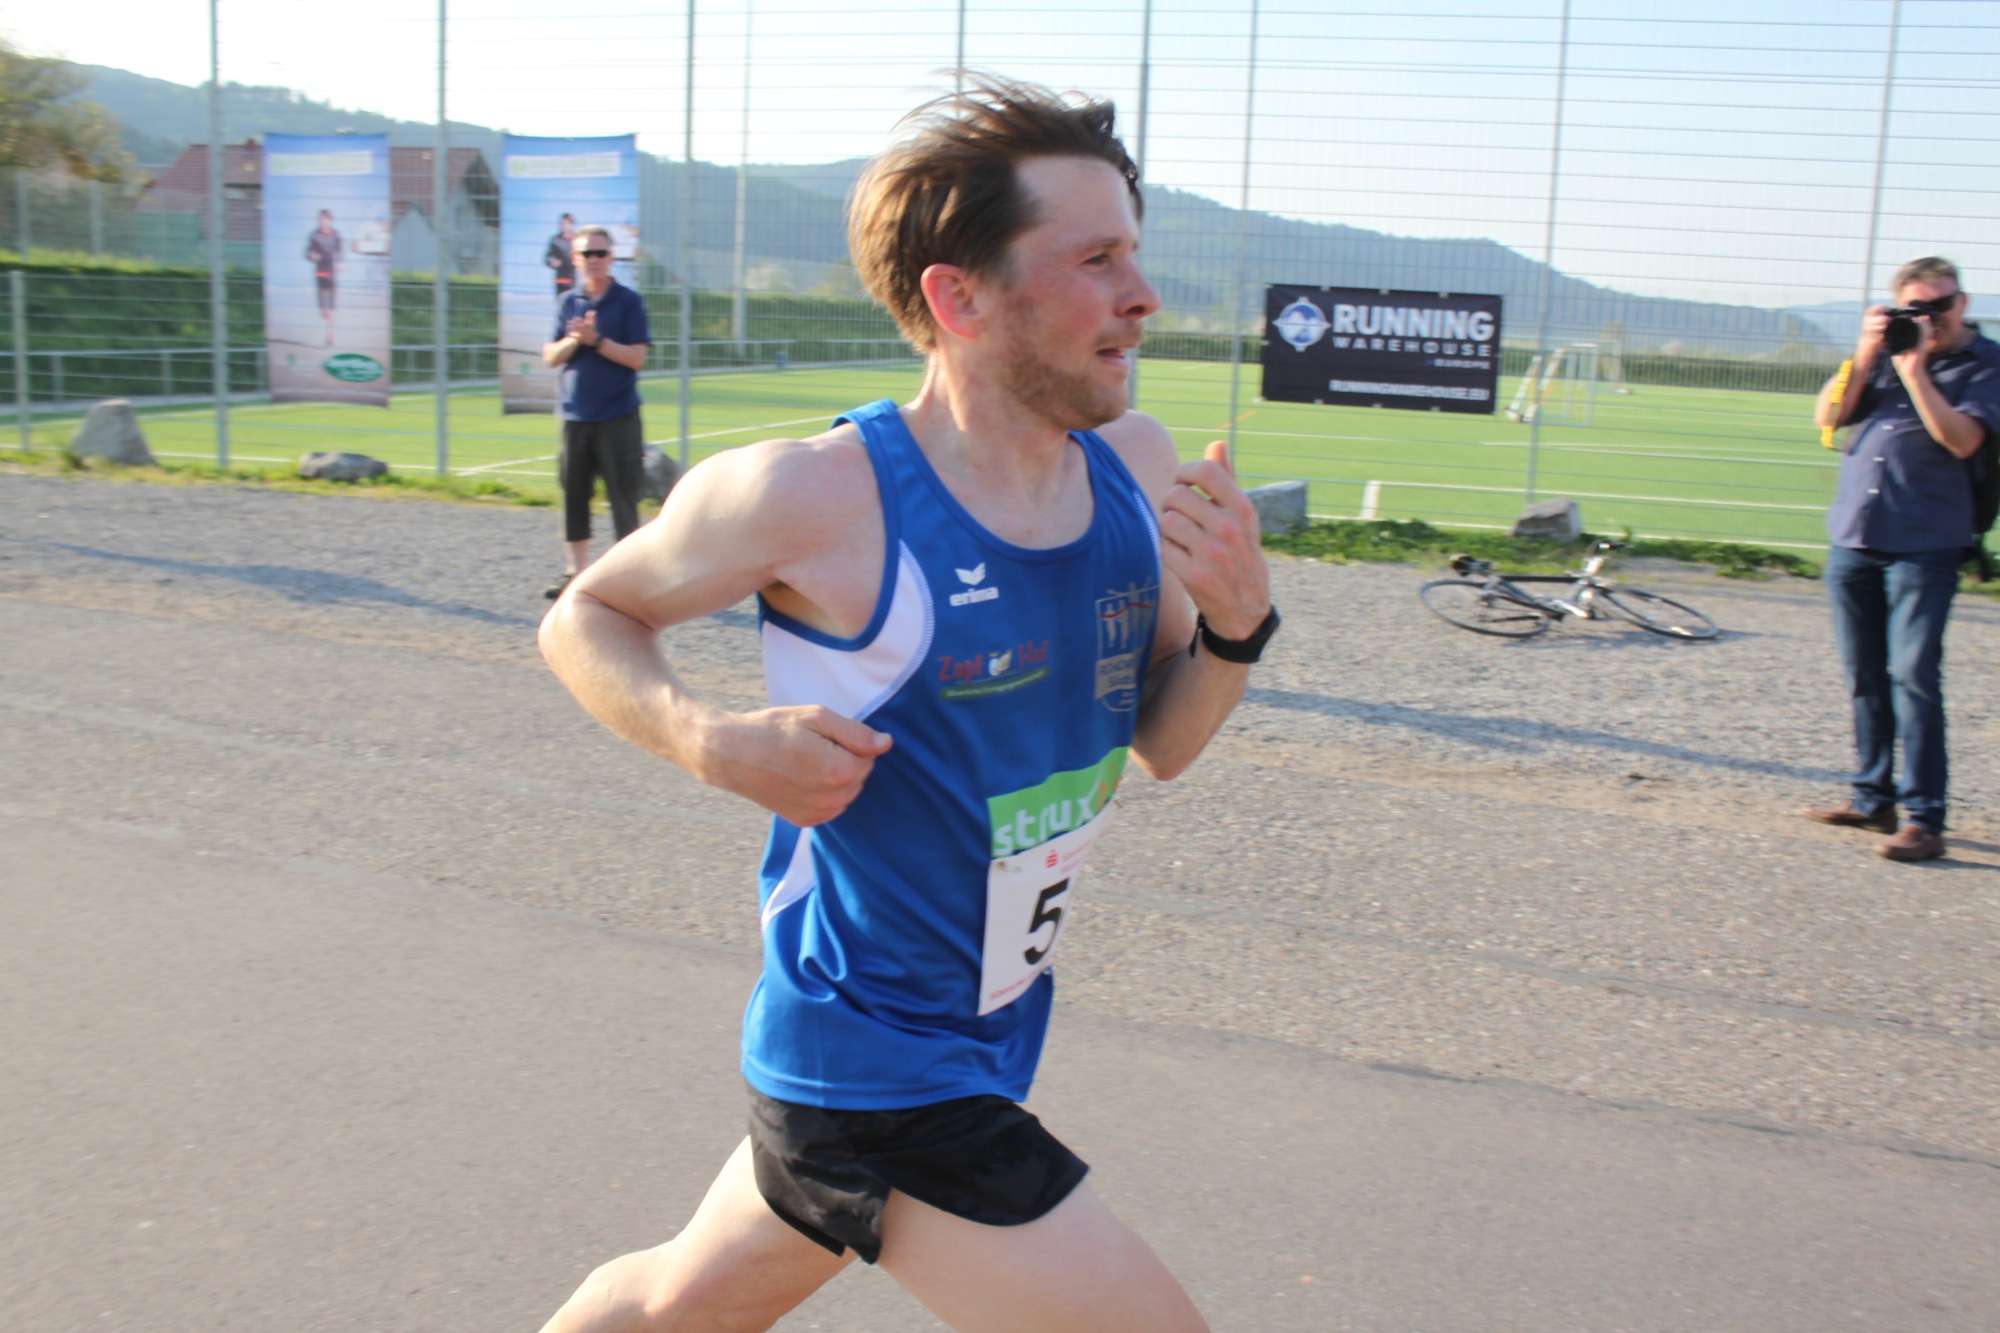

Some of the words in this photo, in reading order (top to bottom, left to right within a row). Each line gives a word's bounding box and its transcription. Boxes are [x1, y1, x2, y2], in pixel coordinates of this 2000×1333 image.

[1333, 304, 1495, 342] RUNNING
[1332, 336, 1492, 358] WAREHOUSE
[949, 587, 999, 607] erima
[938, 655, 983, 683] Zapf
[994, 798, 1095, 856] strux
[1023, 876, 1071, 966] 5
